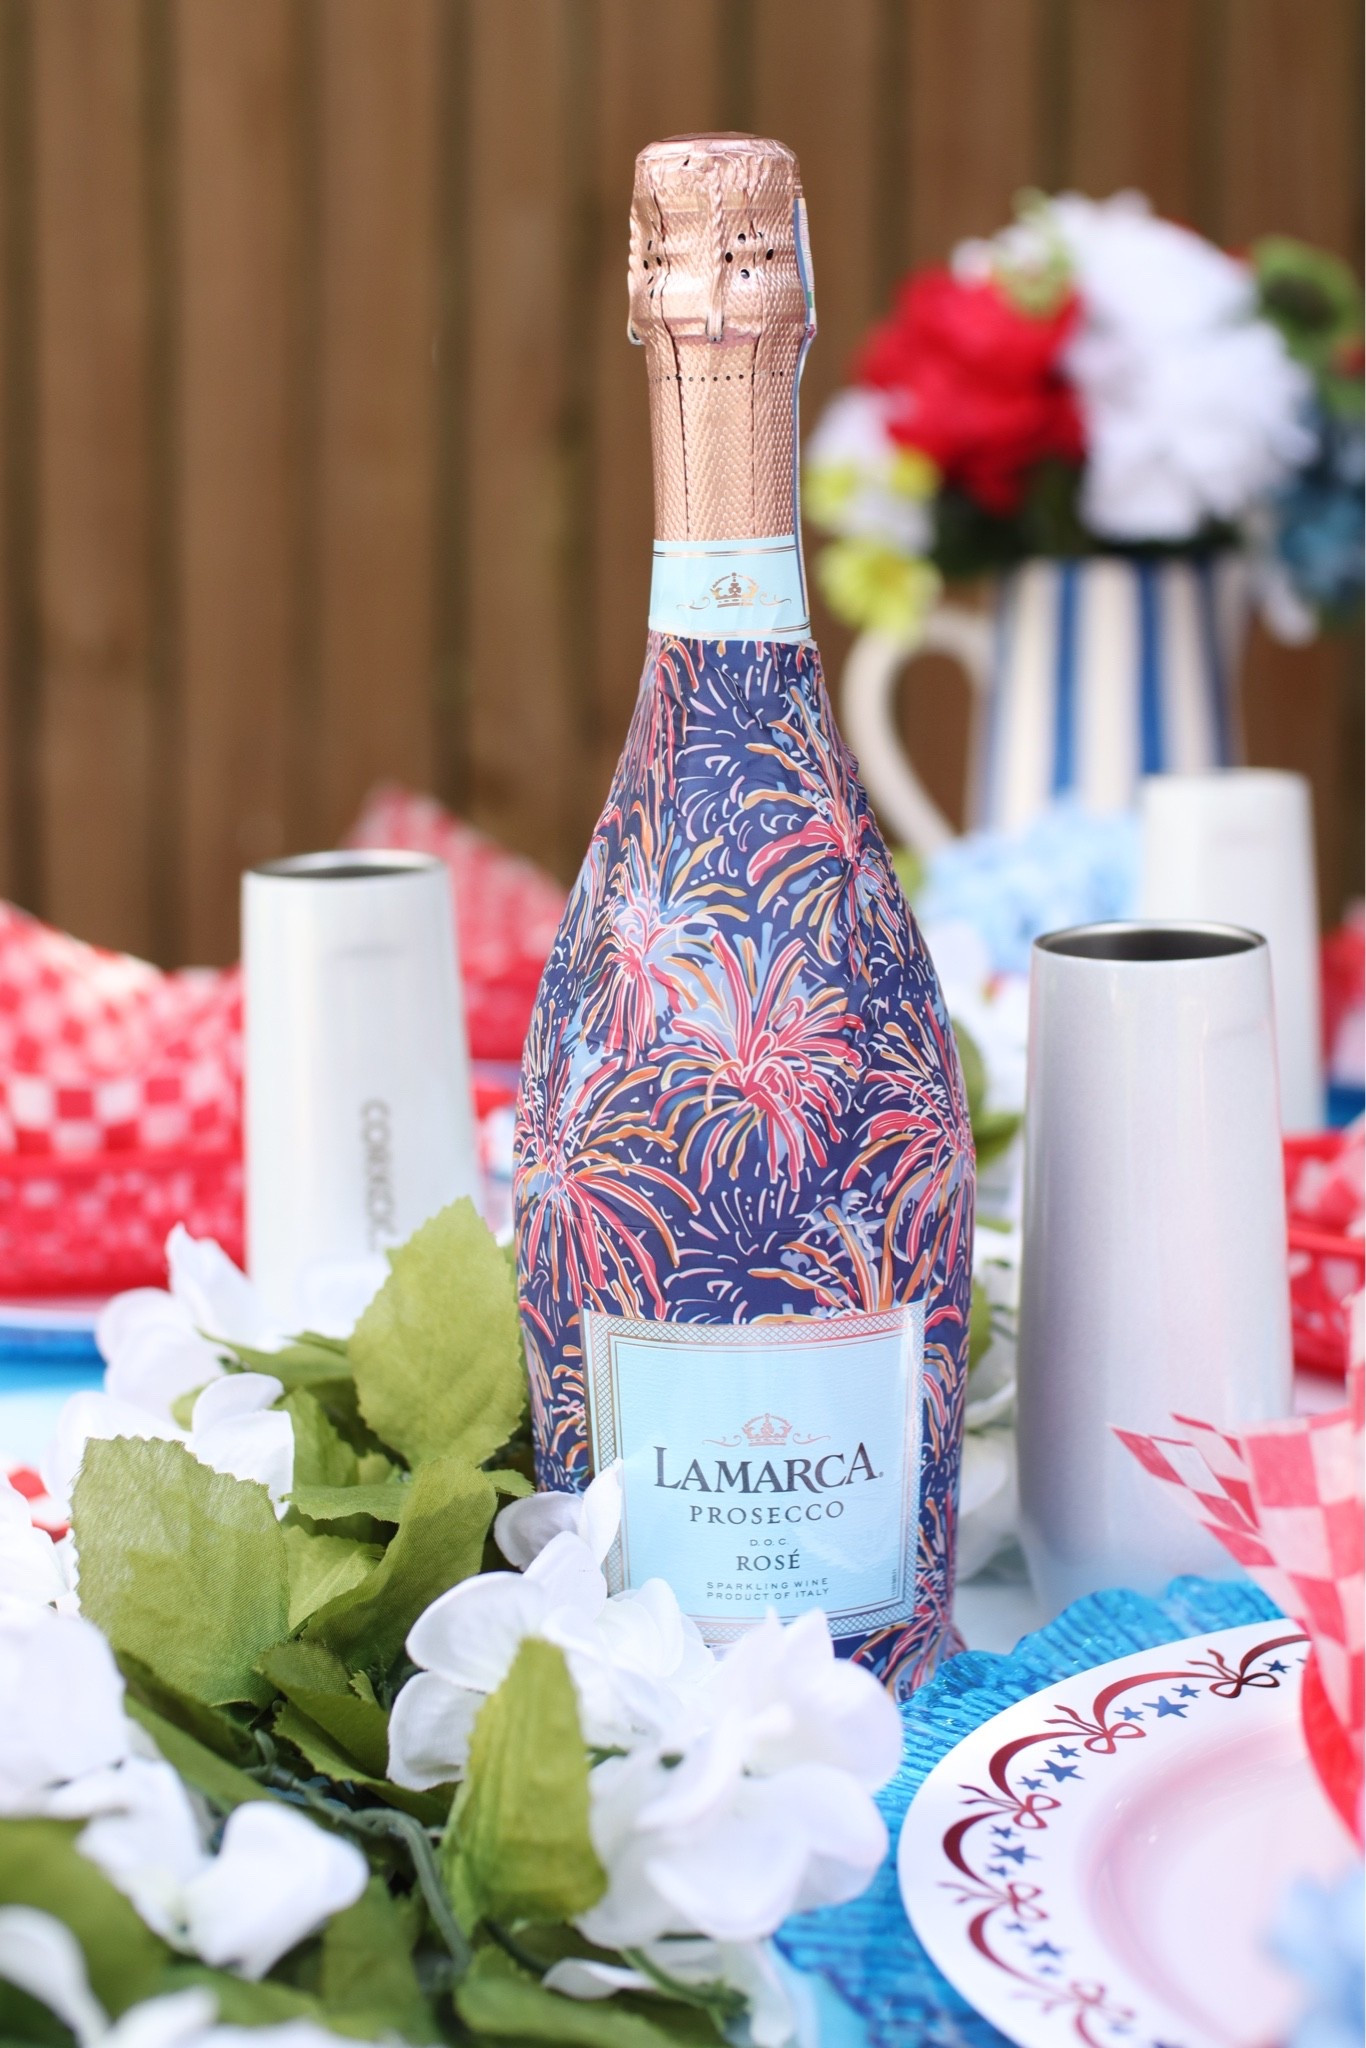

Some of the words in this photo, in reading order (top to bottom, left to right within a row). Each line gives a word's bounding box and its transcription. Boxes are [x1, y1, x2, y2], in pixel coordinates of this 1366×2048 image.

[689, 1500, 845, 1525] PROSECCO
[736, 1548, 801, 1571] ROSÉ
[706, 1581, 789, 1590] SPARKLING
[794, 1577, 829, 1588] WINE
[706, 1591, 770, 1601] PRODUCT
[774, 1591, 791, 1600] OF
[795, 1587, 830, 1599] ITALY
